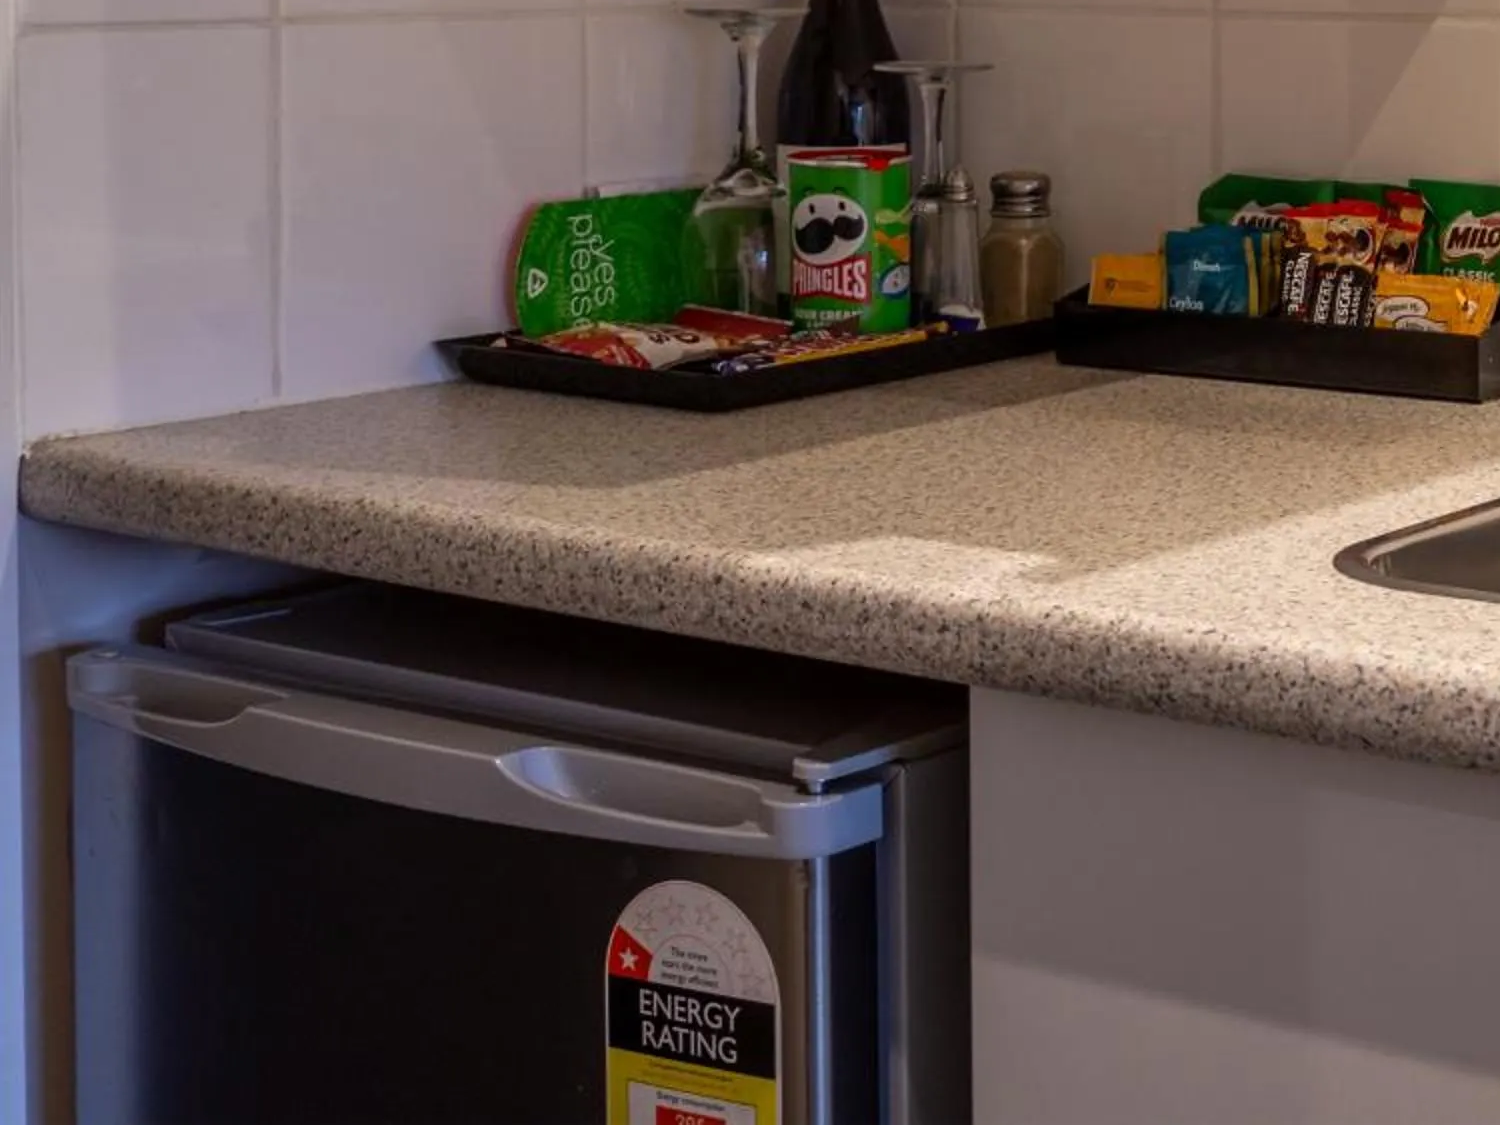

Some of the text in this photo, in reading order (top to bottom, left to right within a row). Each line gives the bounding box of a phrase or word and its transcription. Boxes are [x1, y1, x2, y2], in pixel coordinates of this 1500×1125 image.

[590, 234, 615, 306] yes
[793, 258, 868, 299] PRINGLES
[639, 988, 742, 1032] ENERGY
[641, 1020, 738, 1064] RATING
